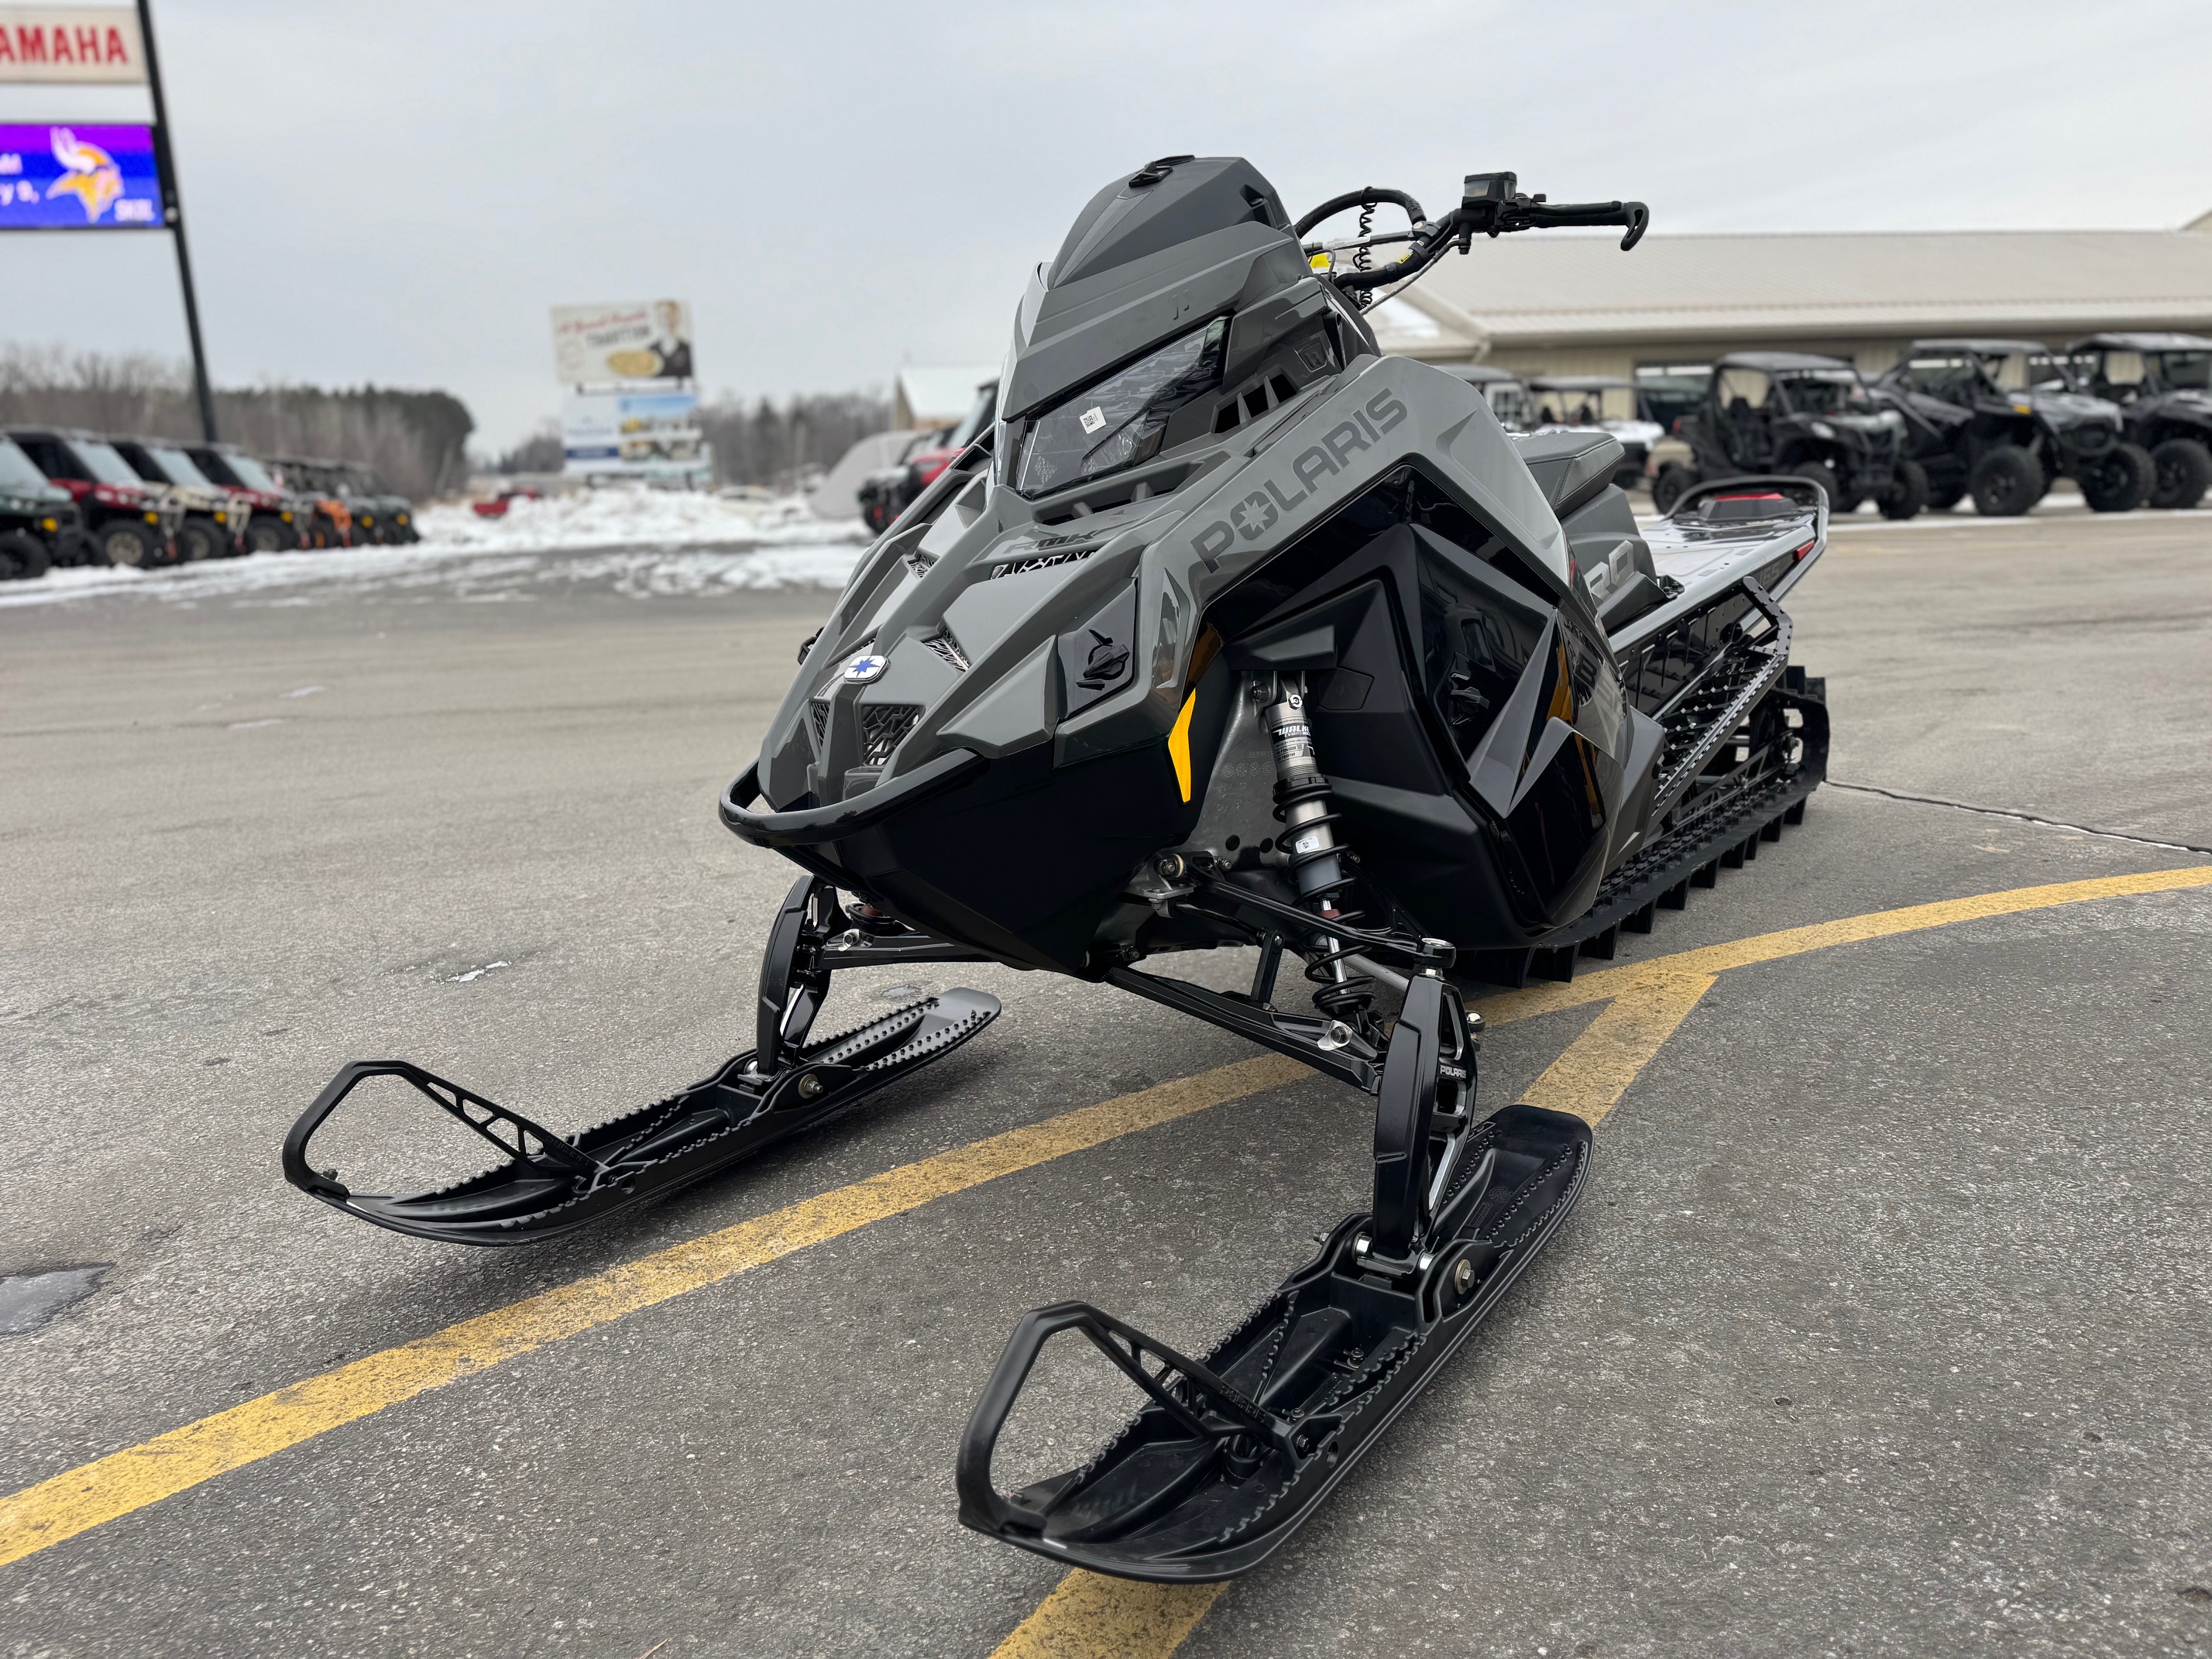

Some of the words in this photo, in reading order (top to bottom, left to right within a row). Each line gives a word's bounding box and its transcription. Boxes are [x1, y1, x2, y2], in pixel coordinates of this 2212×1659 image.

[1190, 388, 1408, 574] POLARIS
[1439, 1064, 1467, 1079] POLARIS
[1220, 1382, 1266, 1424] POLARIS
